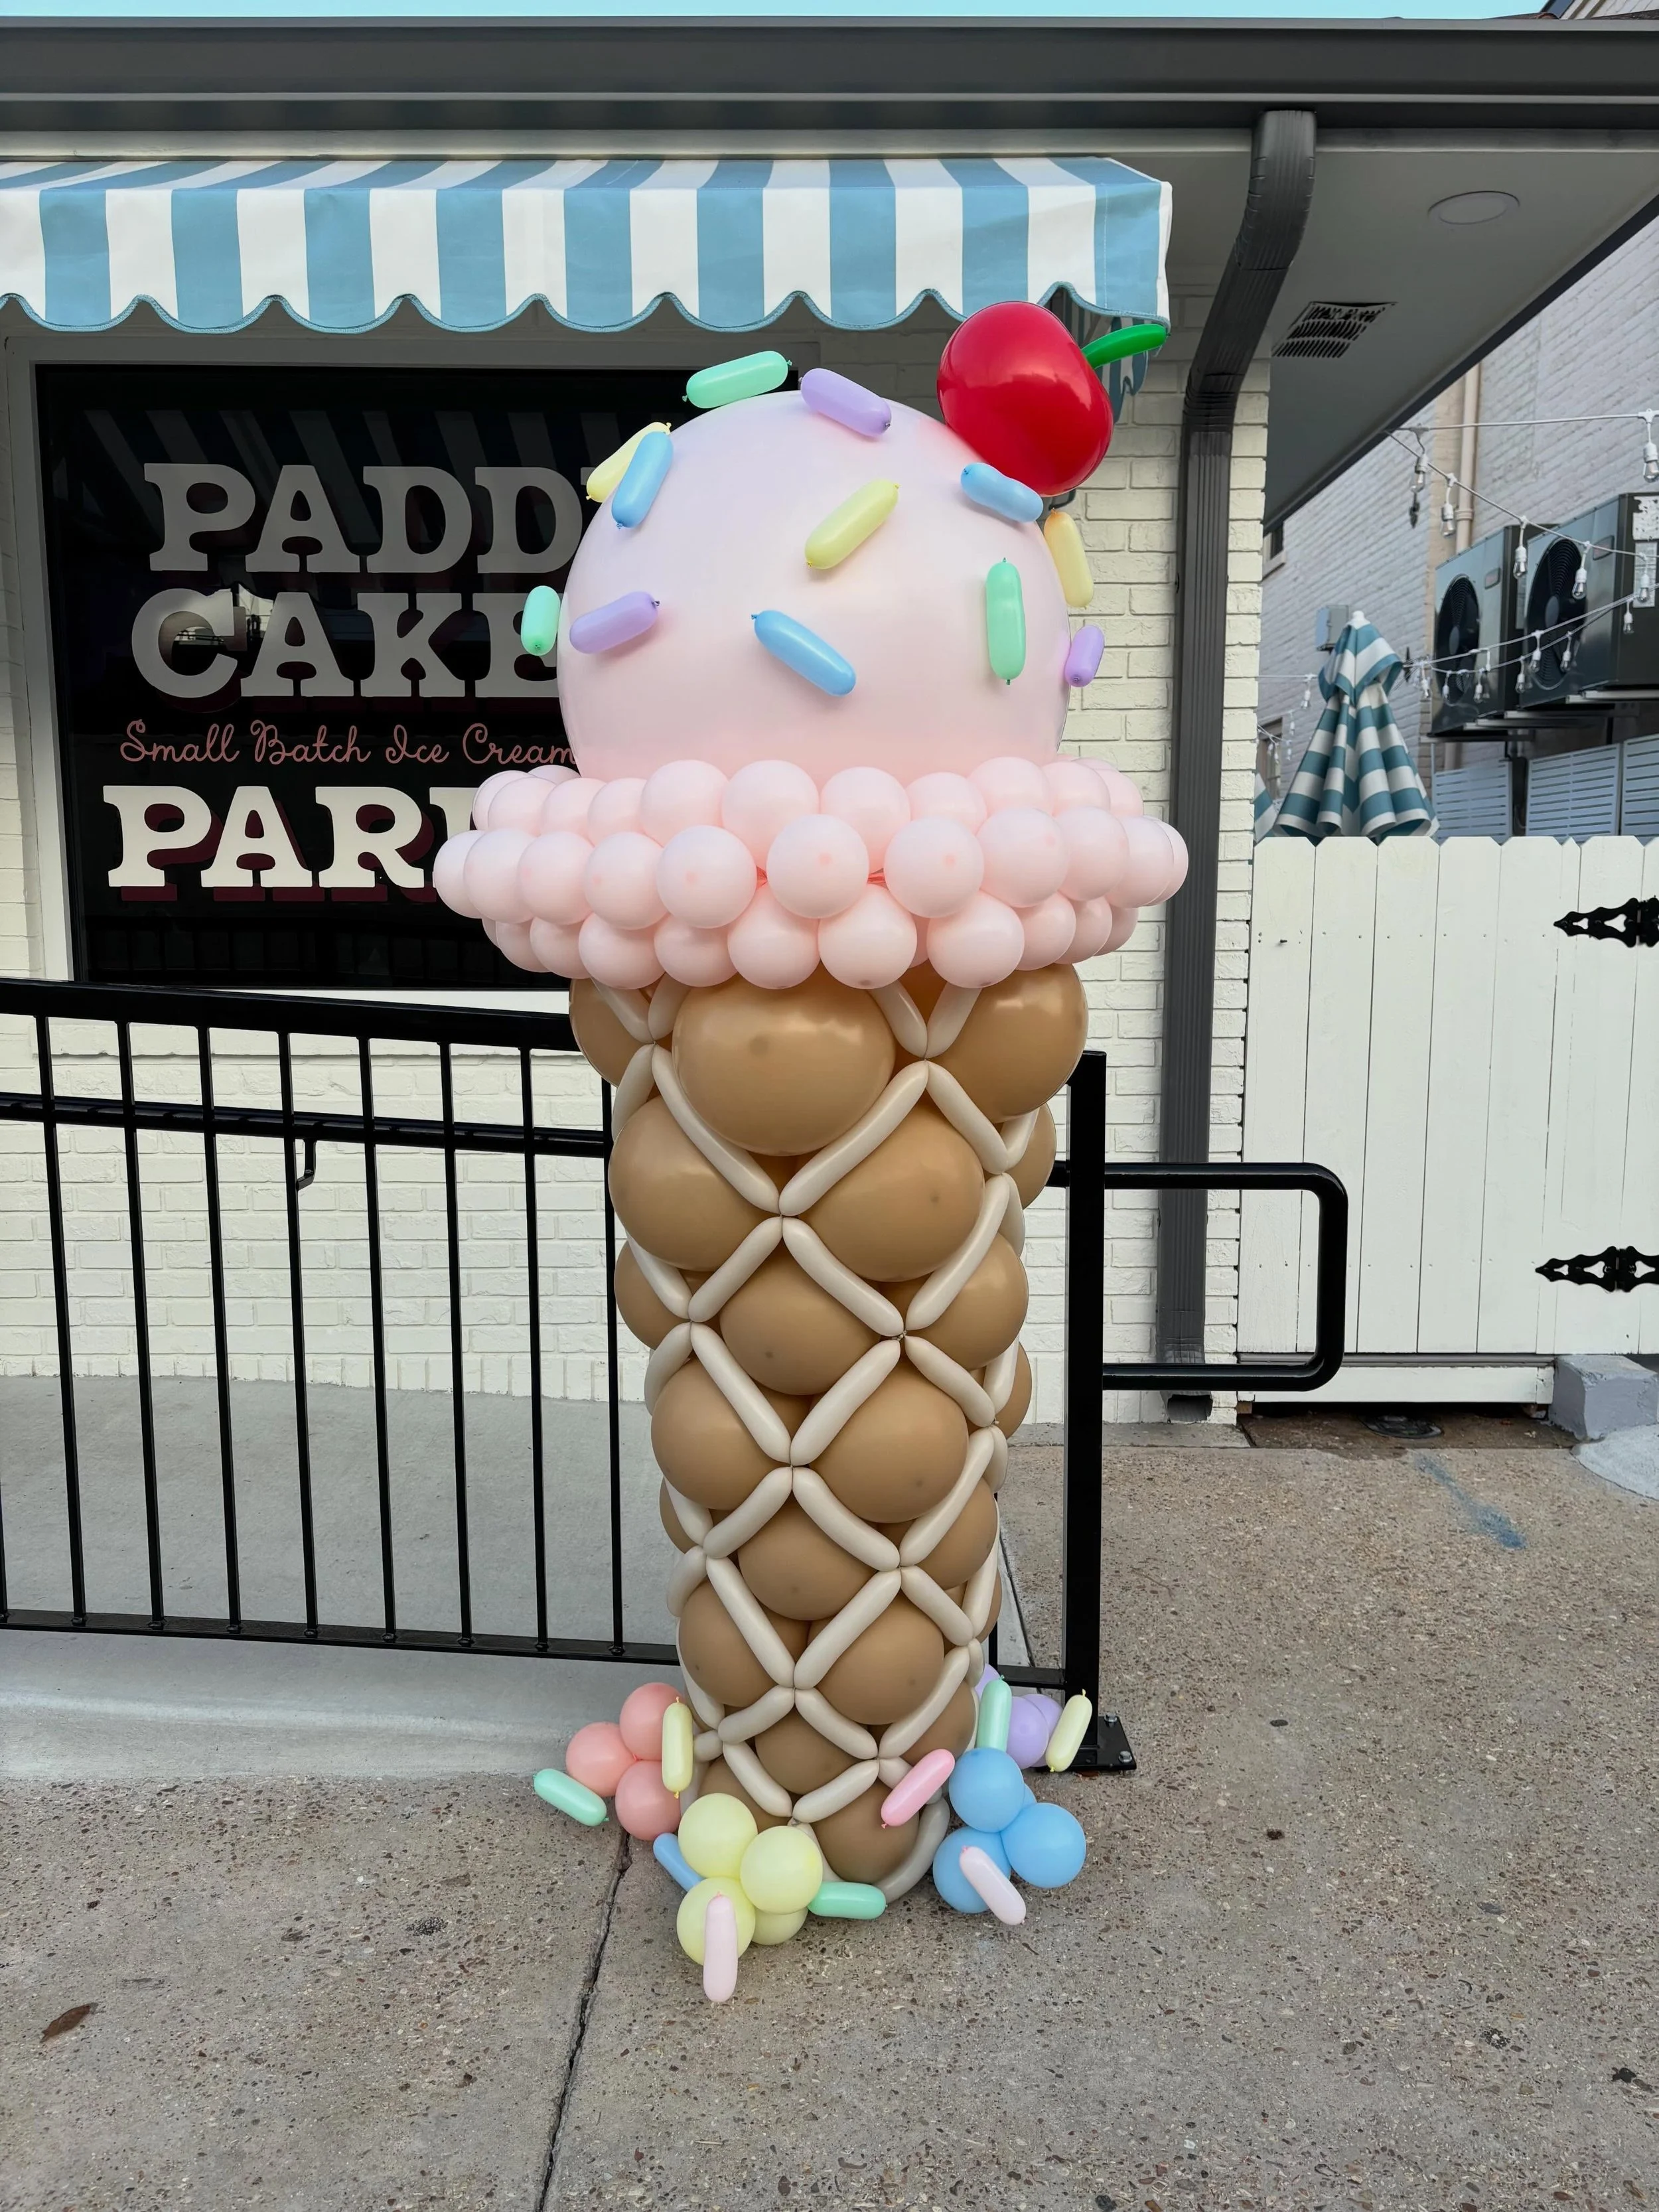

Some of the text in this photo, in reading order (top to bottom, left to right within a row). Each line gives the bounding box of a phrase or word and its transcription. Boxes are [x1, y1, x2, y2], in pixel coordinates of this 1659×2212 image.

[144, 463, 598, 573] PADD
[120, 719, 240, 763] Small
[250, 719, 371, 765] Batch
[385, 724, 449, 764] Ice
